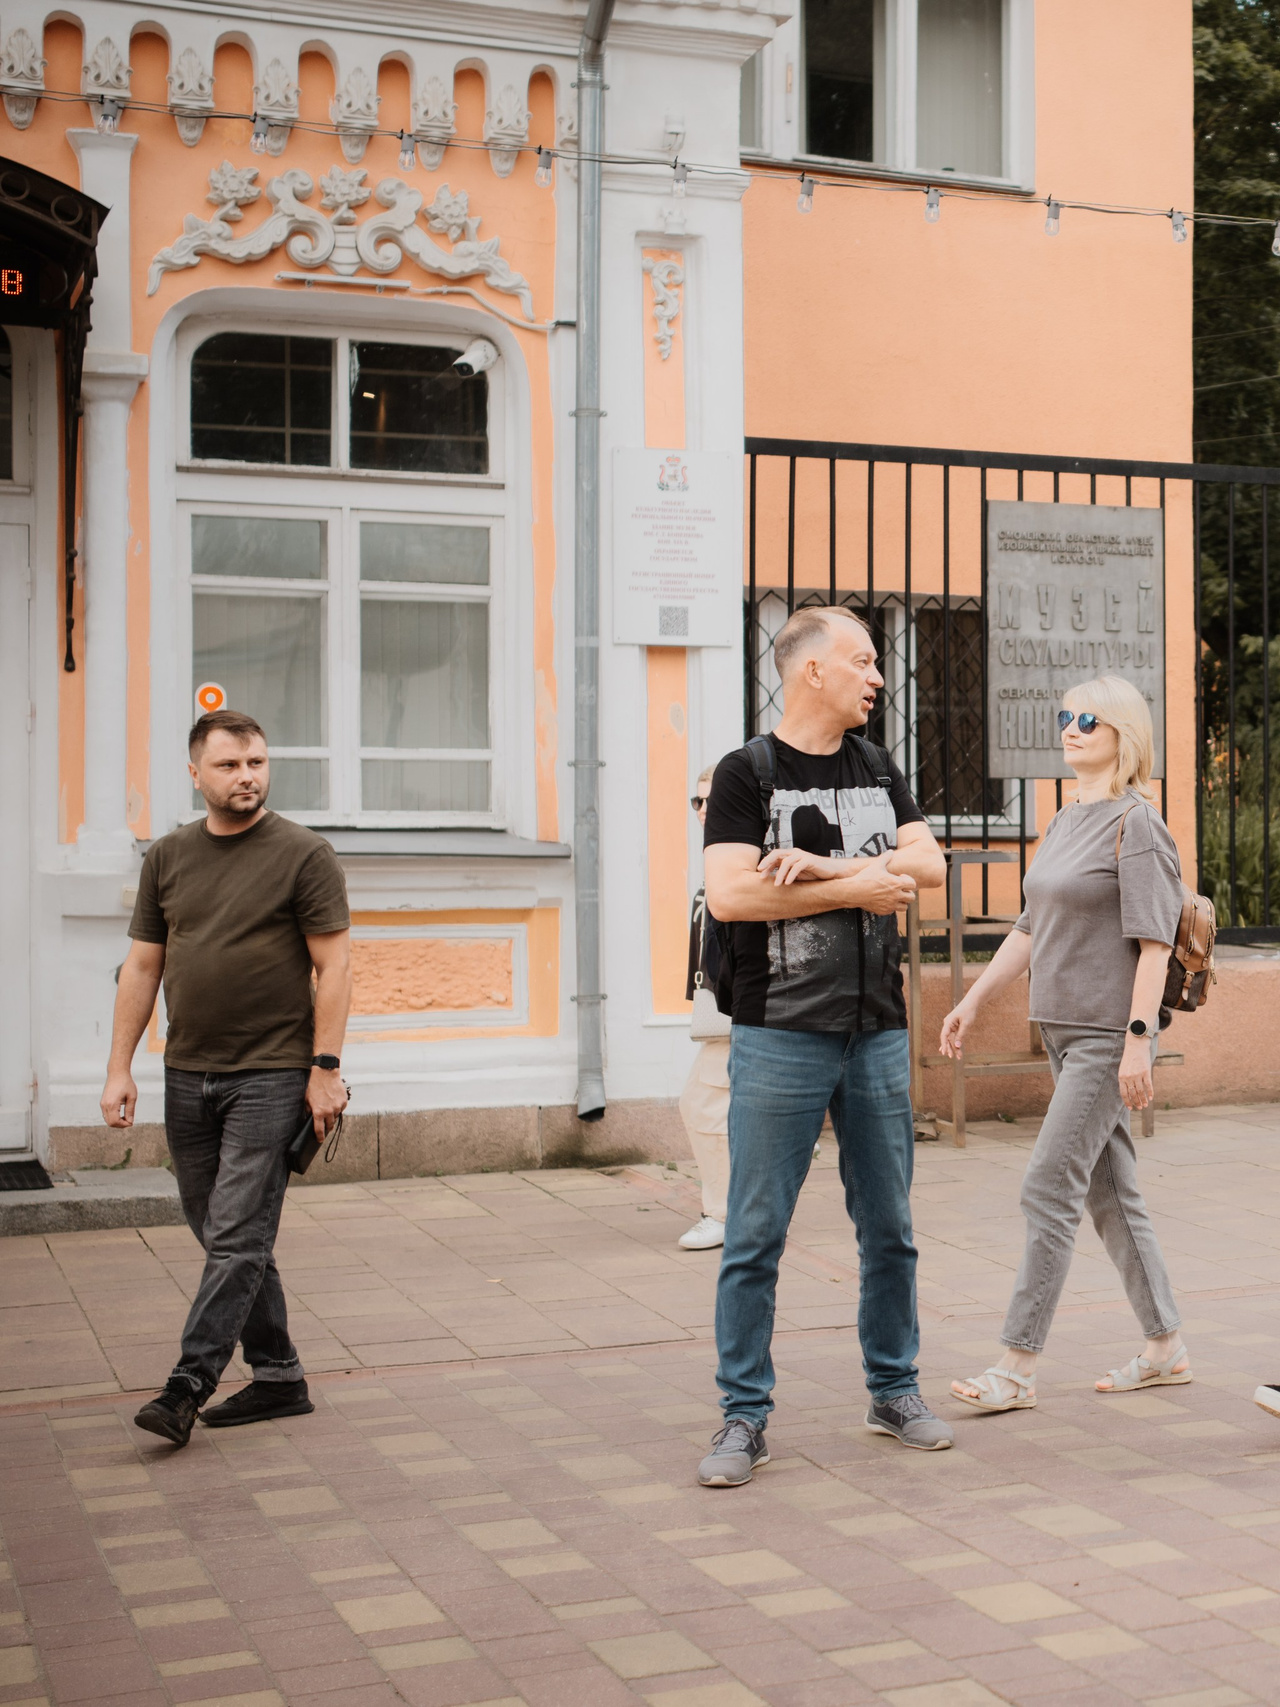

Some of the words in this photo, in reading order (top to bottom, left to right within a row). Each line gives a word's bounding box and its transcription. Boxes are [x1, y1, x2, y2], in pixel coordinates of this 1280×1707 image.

[998, 531, 1061, 543] СМОЛЕНСКИЙ
[998, 580, 1155, 634] МУЗЕЙ
[999, 637, 1155, 669] СКУЛЬПТУРЫ
[999, 688, 1050, 700] СЕРГЕЯ
